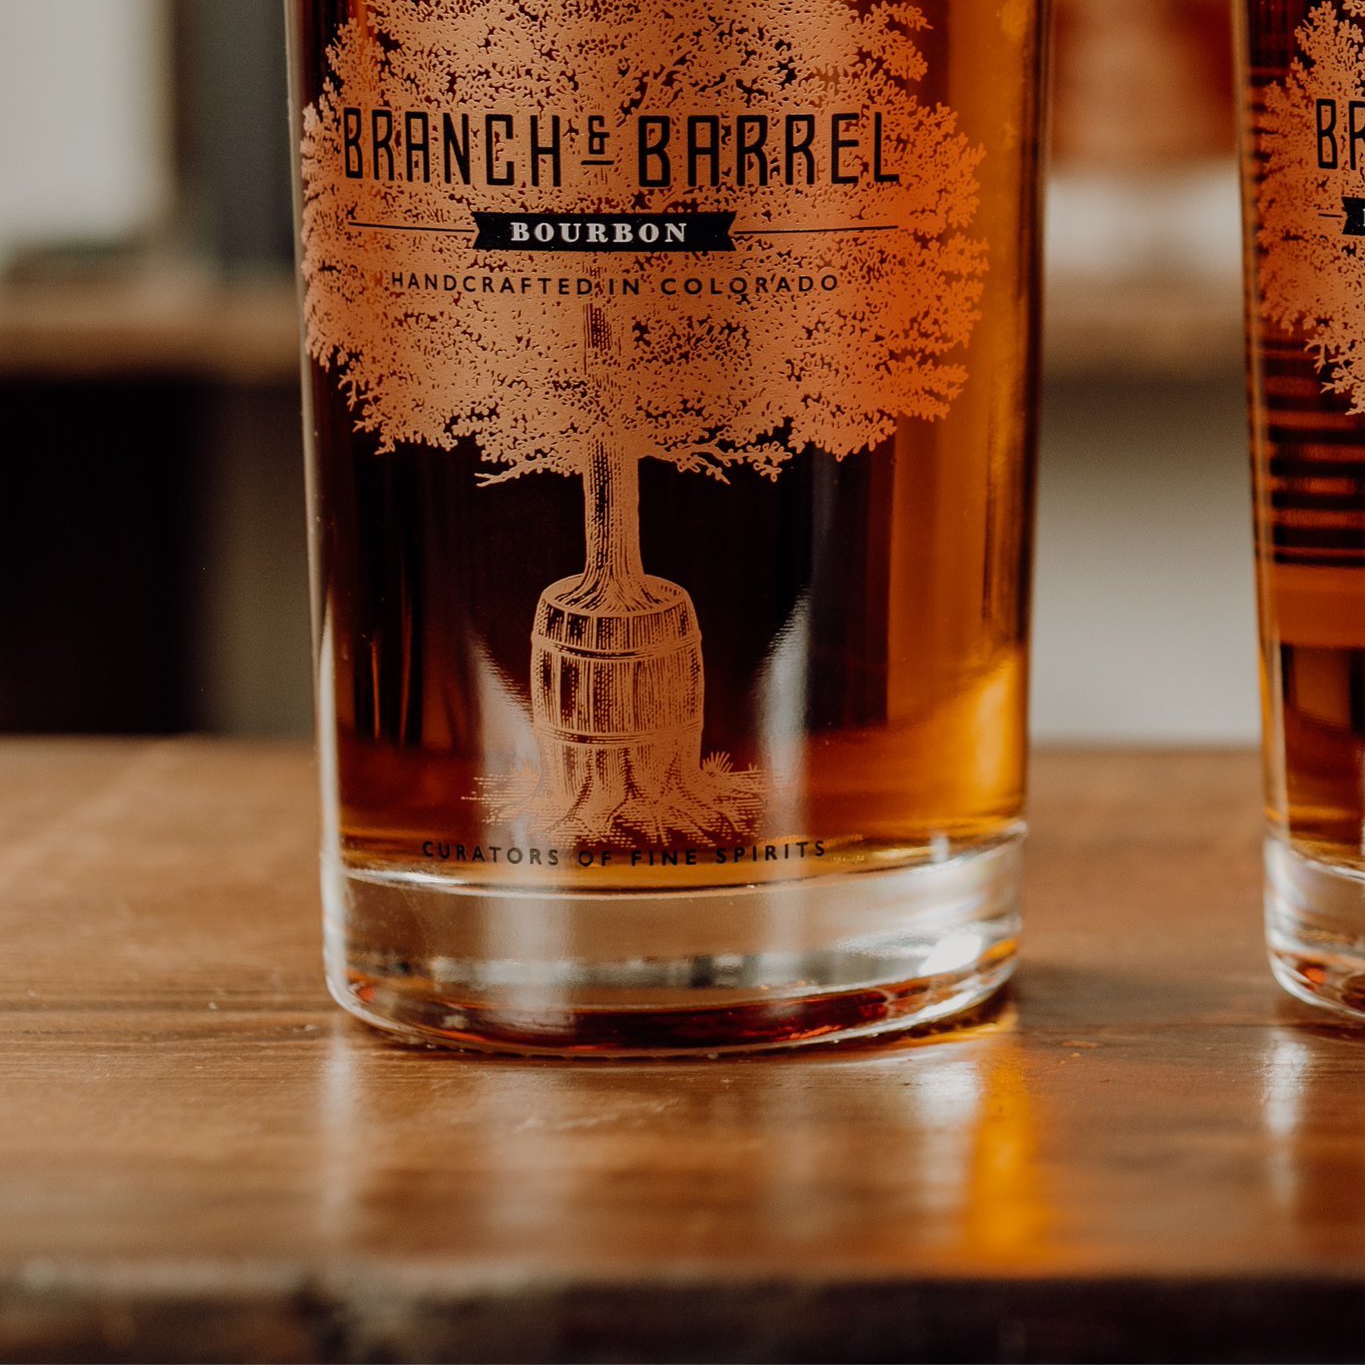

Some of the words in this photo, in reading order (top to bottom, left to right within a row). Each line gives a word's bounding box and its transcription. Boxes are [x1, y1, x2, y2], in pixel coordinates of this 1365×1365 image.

[343, 106, 562, 188] BRANCH
[580, 113, 614, 166] &
[637, 109, 901, 189] BARREL
[509, 220, 688, 243] BOURBON
[390, 272, 593, 296] HANDCRAFTED
[607, 277, 639, 296] IN
[662, 276, 839, 296] COLORADO
[422, 840, 560, 866] CURATORS
[578, 851, 612, 867] OF
[630, 850, 698, 867] FINE
[715, 839, 826, 864] SPIRITS
